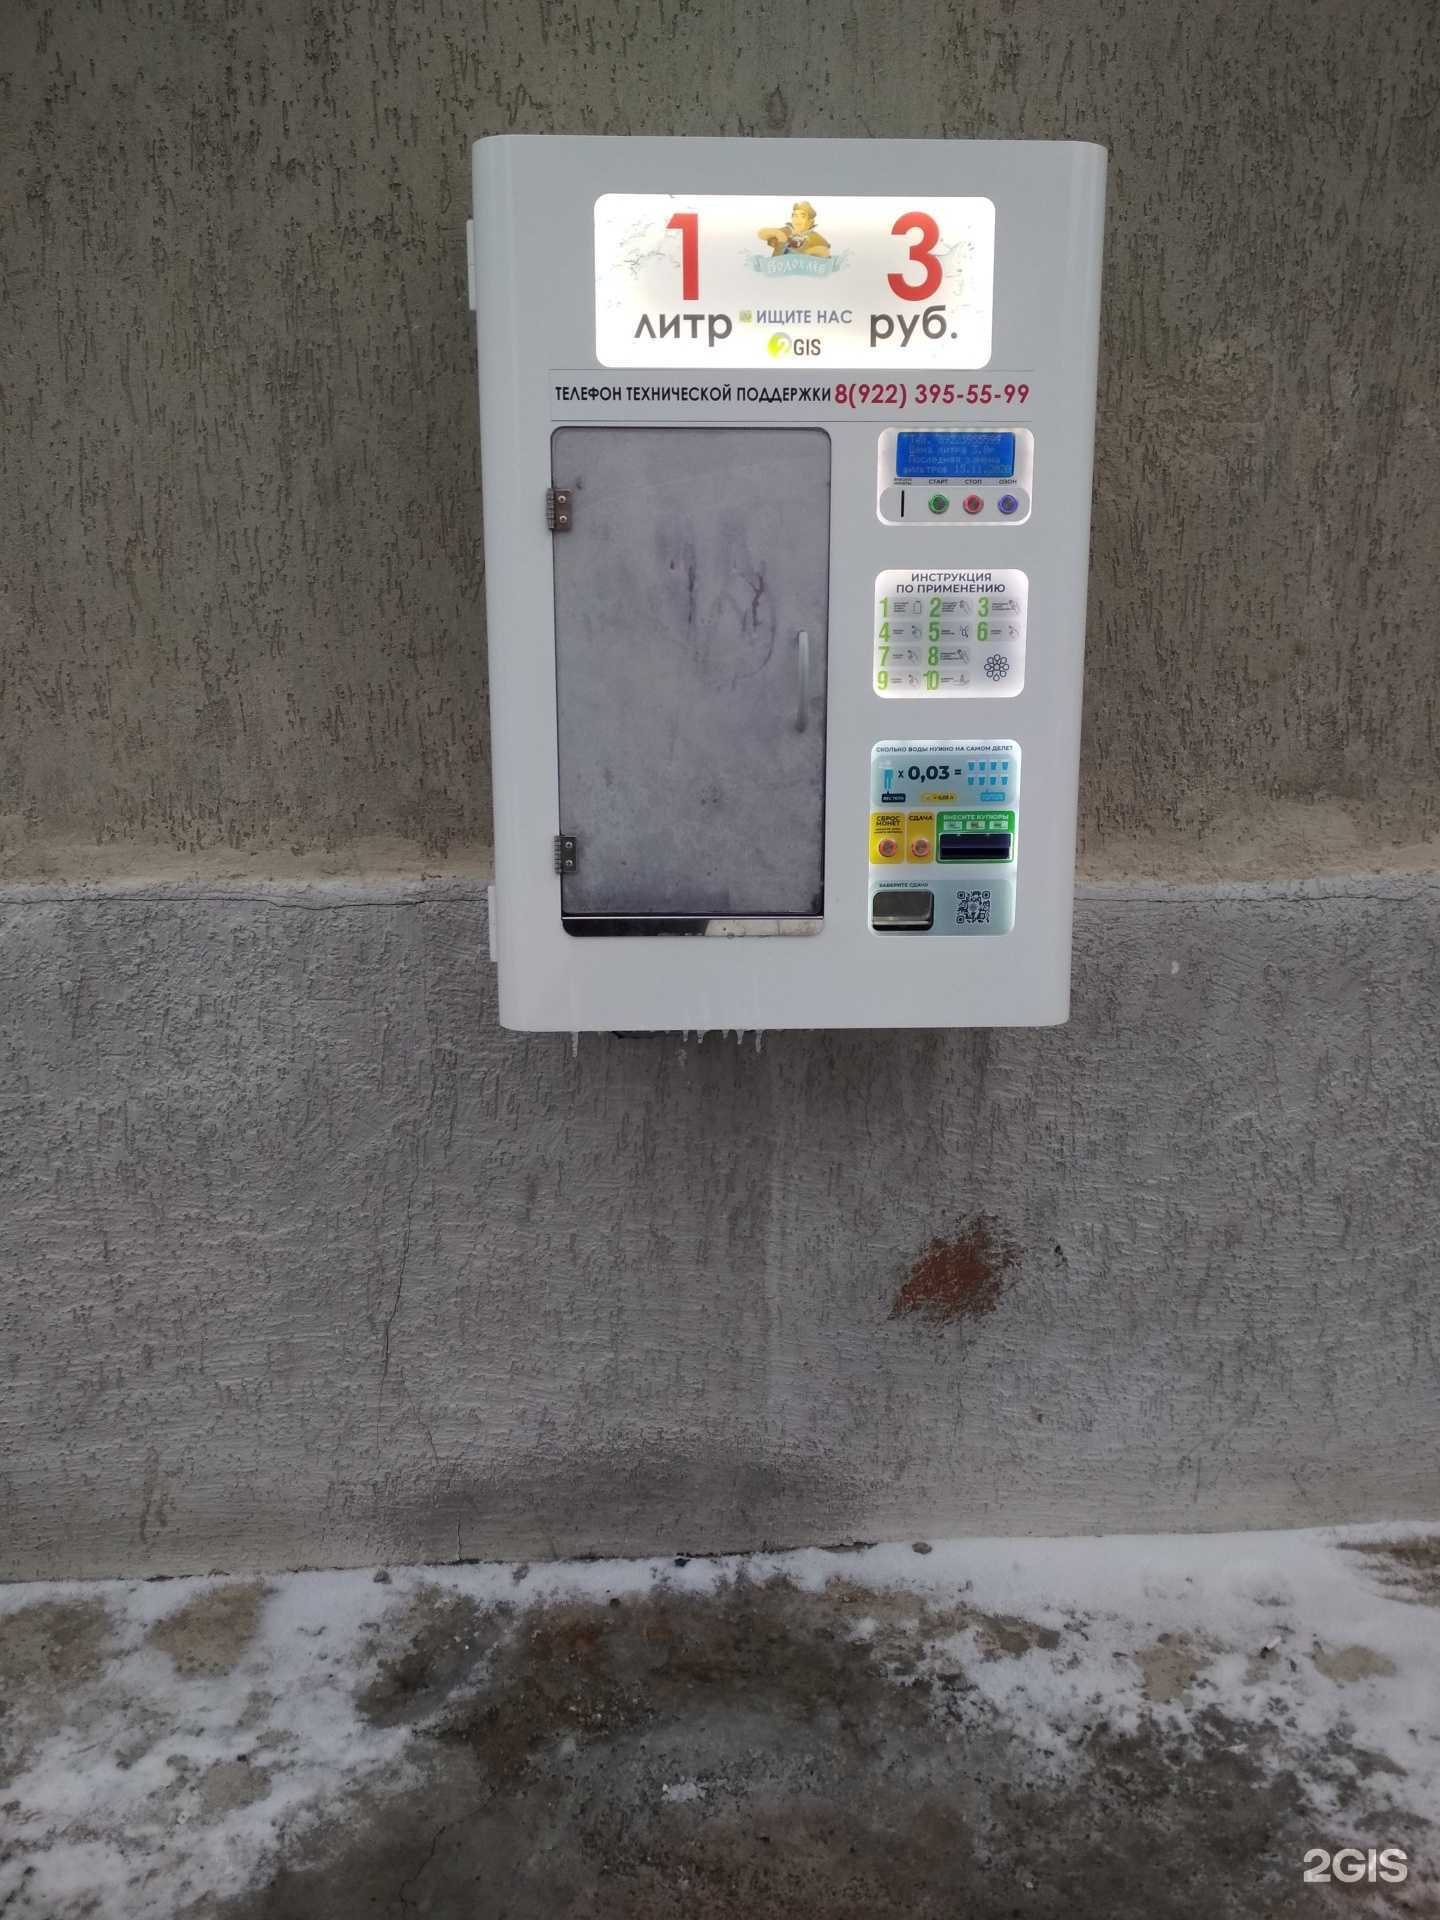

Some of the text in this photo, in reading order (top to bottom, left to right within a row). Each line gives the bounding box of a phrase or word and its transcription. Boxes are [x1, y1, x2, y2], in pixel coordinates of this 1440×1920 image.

[665, 213, 700, 301] 1
[887, 211, 944, 302] 3
[756, 310, 854, 325] ИЩИТЕ НАС
[869, 304, 959, 348] руб.
[634, 312, 733, 347] литр
[555, 383, 1030, 409] ТЕЛЕФОН ТЕХНИЧЕСКОЙ ПОДДЕРЖКИ 8(922) 395-55-99
[911, 573, 992, 583] ИНСТРУКЦИЯ
[896, 584, 1006, 593] ПО ПРИМЕНЕНИЮ
[879, 597, 889, 618] 1
[929, 597, 942, 618] 2
[978, 597, 989, 618] 3
[878, 622, 890, 642] 4
[928, 622, 940, 641] 5
[976, 622, 988, 641] 6
[878, 646, 890, 666] 7
[927, 646, 939, 666] 8
[877, 671, 889, 690] 9
[923, 670, 939, 690] 10
[908, 766, 950, 783] 0,03
